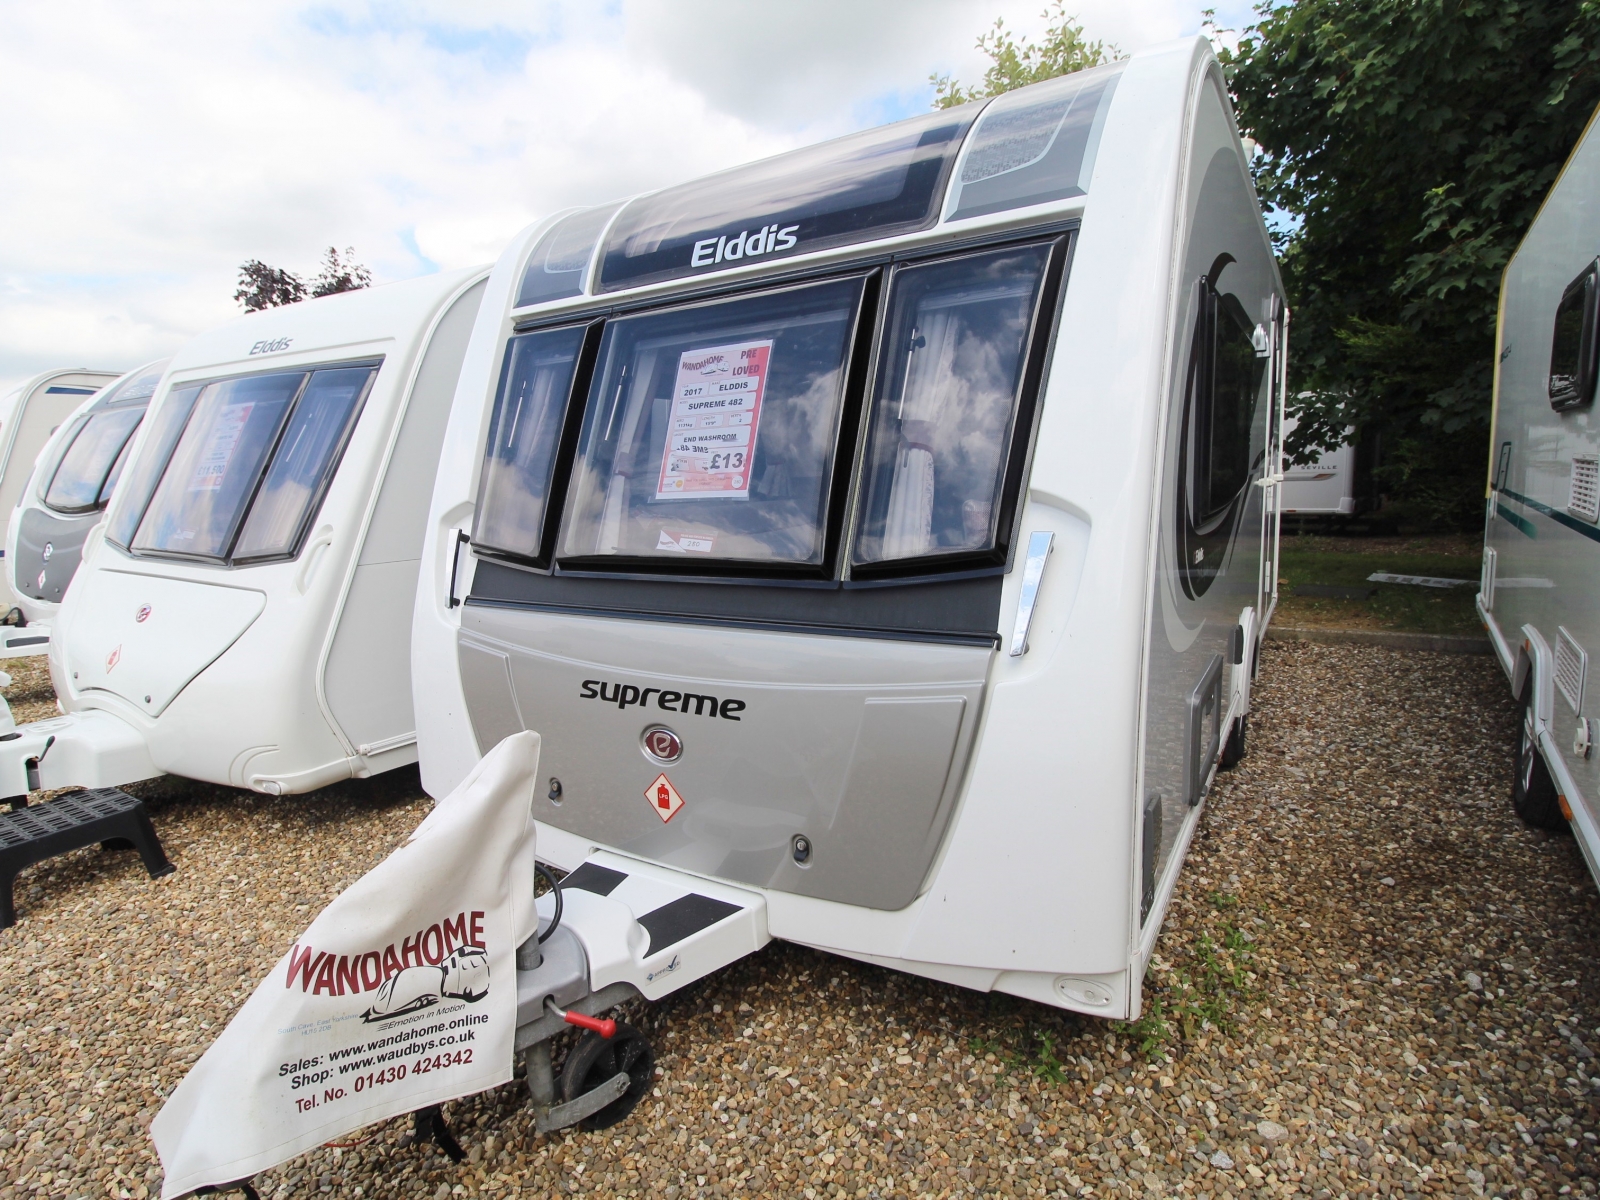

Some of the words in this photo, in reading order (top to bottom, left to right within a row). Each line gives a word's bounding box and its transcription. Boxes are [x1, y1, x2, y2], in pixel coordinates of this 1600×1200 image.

[690, 223, 800, 268] Elddis
[249, 337, 294, 356] Elddis
[740, 349, 758, 360] PRE
[682, 355, 725, 371] WANDAHOME
[732, 364, 760, 377] LOVED
[683, 388, 703, 397] 2017
[719, 381, 749, 392] ELDDIS
[688, 399, 727, 410] SUPREME
[728, 398, 744, 406] 482
[698, 433, 737, 442] WASHROOM
[579, 679, 747, 722] supreme
[286, 911, 486, 997] WANDAHOME
[277, 1026, 297, 1035] South
[316, 1018, 331, 1026] East
[332, 1014, 359, 1023] Yorkshire
[388, 1013, 424, 1030] Emotion
[426, 1011, 435, 1019] in
[436, 1003, 466, 1016] Motion
[278, 1055, 324, 1077] Sales:
[328, 1014, 489, 1062] www.wandahome.online
[291, 1068, 334, 1090] Shop:
[339, 1029, 475, 1075] www.waudbys.co.uk
[295, 1094, 320, 1114] Tel.
[323, 1087, 348, 1104] No.
[354, 1064, 407, 1093] 01430
[411, 1048, 473, 1076] 424342
